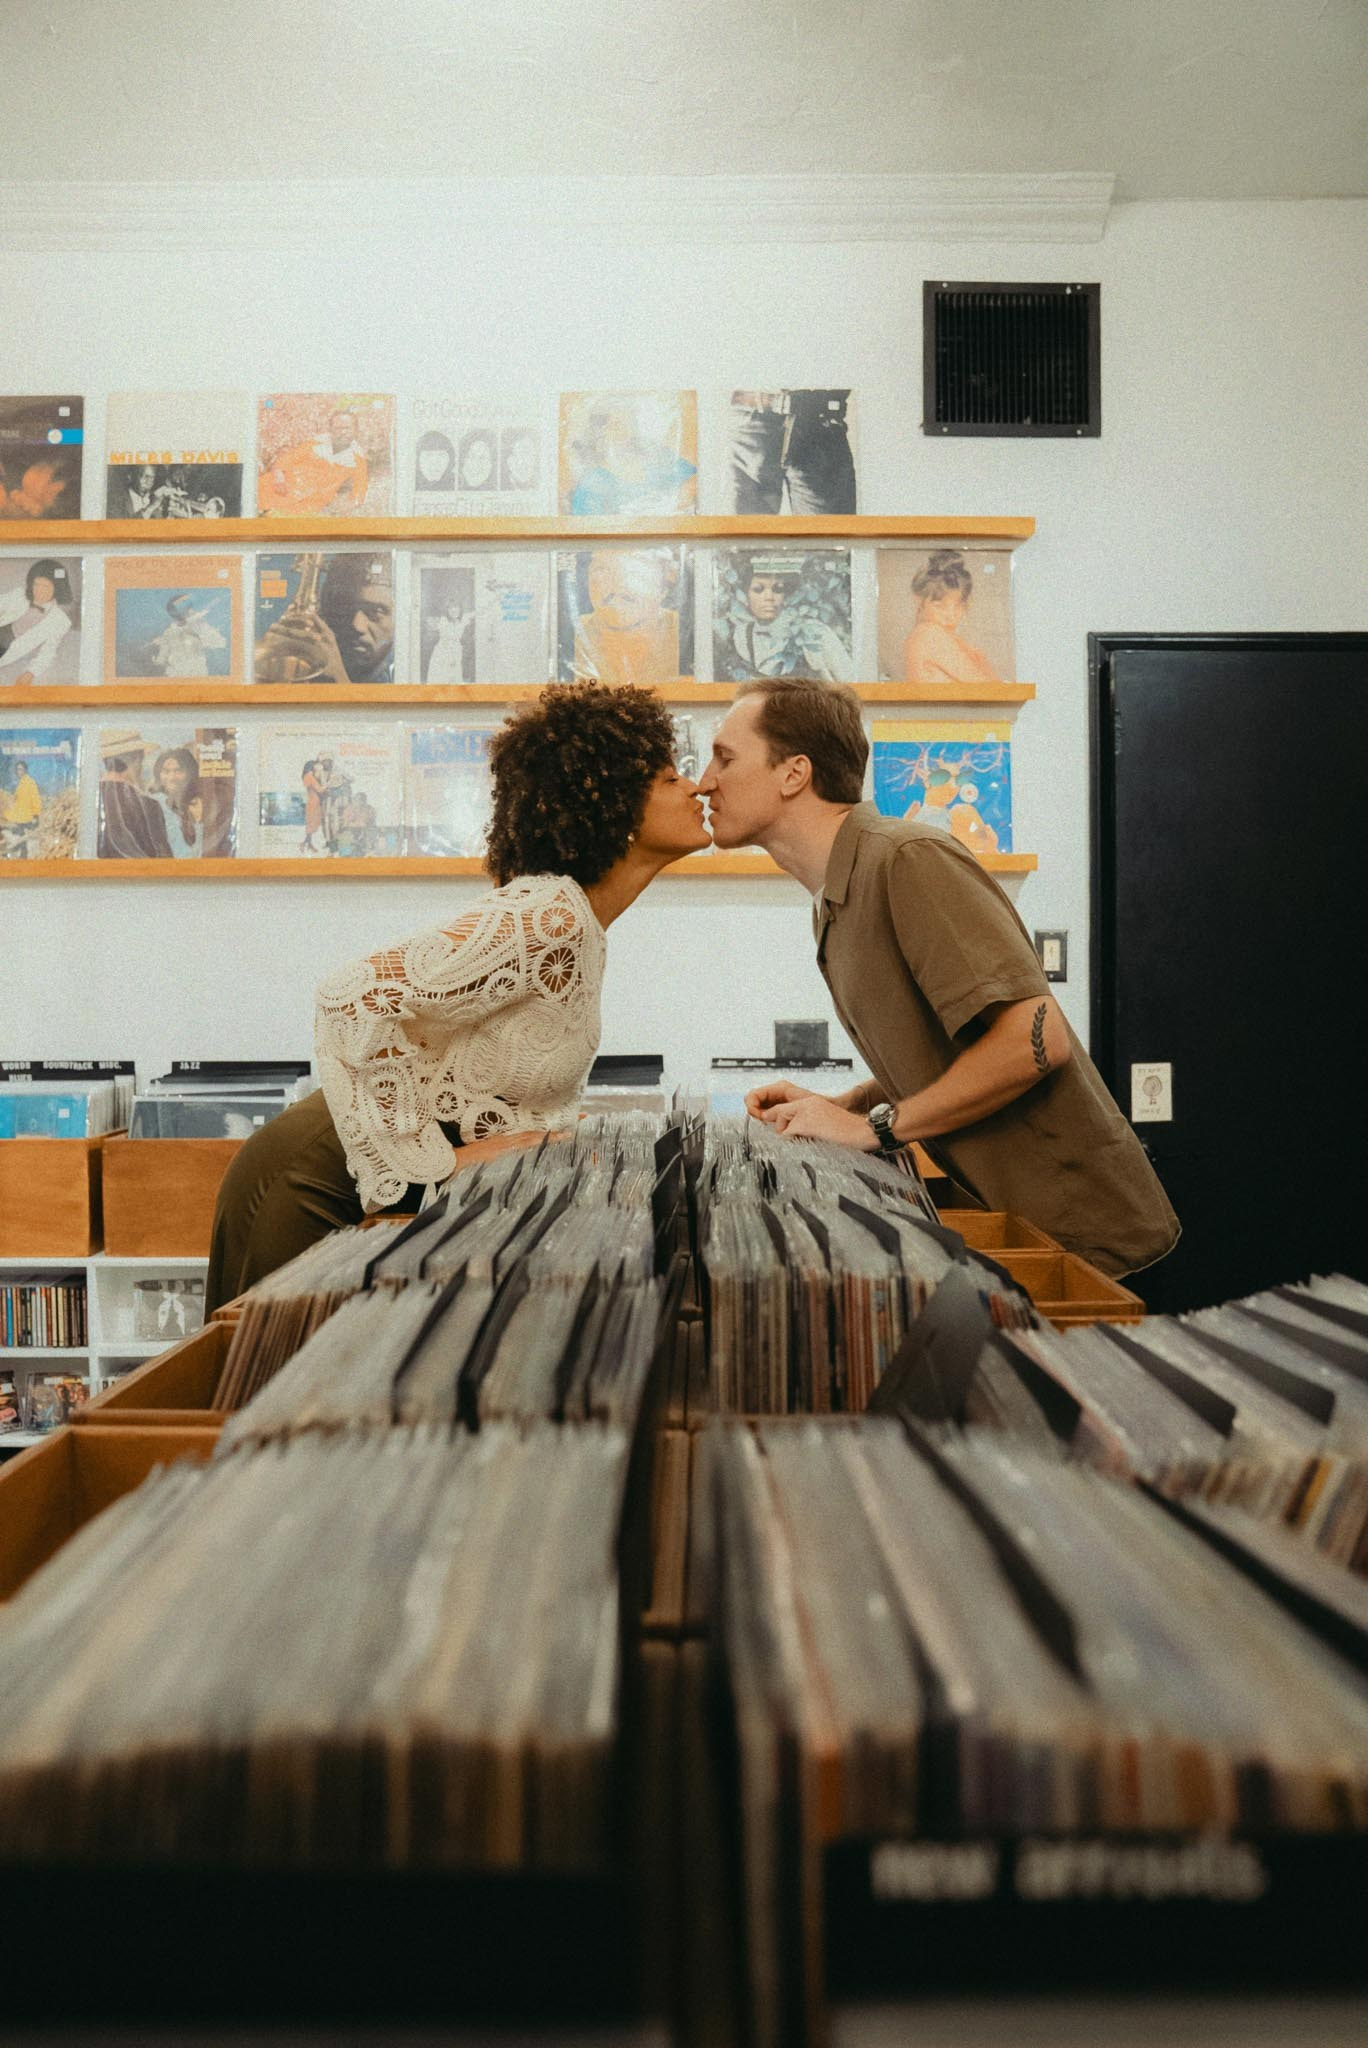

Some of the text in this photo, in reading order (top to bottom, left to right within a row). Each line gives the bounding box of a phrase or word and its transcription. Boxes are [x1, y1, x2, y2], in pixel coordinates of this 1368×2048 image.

[181, 451, 239, 464] DAVIS
[43, 1062, 94, 1071] SOUNDTRACK
[180, 1061, 201, 1070] JAZZ
